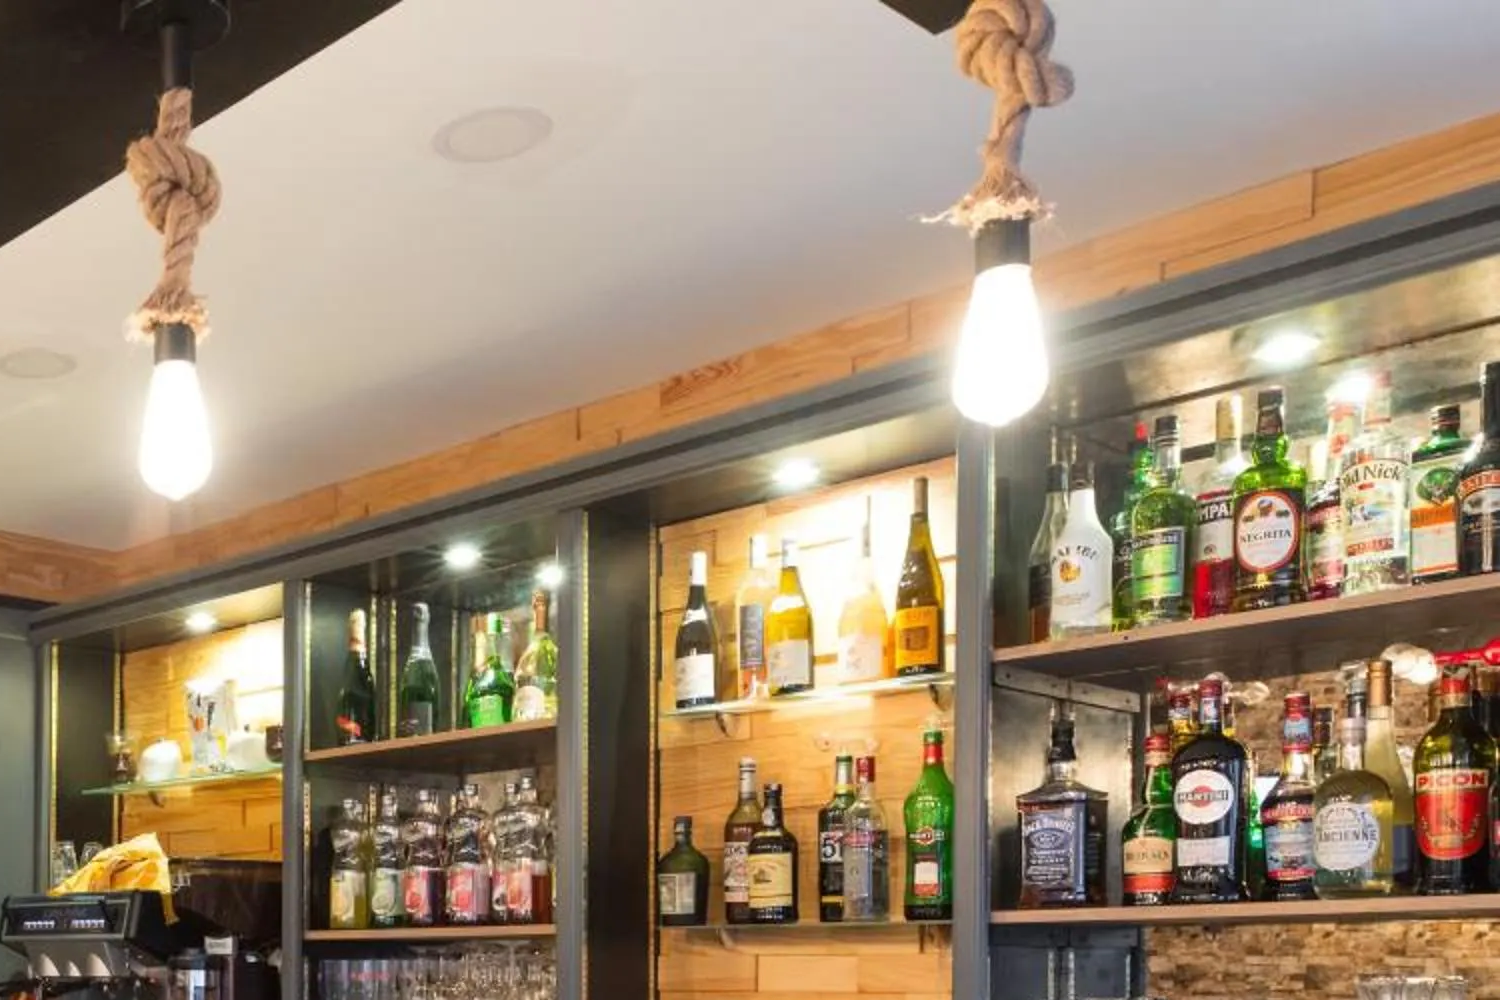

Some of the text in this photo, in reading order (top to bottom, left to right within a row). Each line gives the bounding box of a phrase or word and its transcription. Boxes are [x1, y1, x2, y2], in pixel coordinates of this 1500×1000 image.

[1364, 463, 1400, 481] Nick
[1240, 529, 1292, 544] NEGRITA
[1418, 771, 1486, 788] PICON
[1178, 789, 1229, 804] MARTINI
